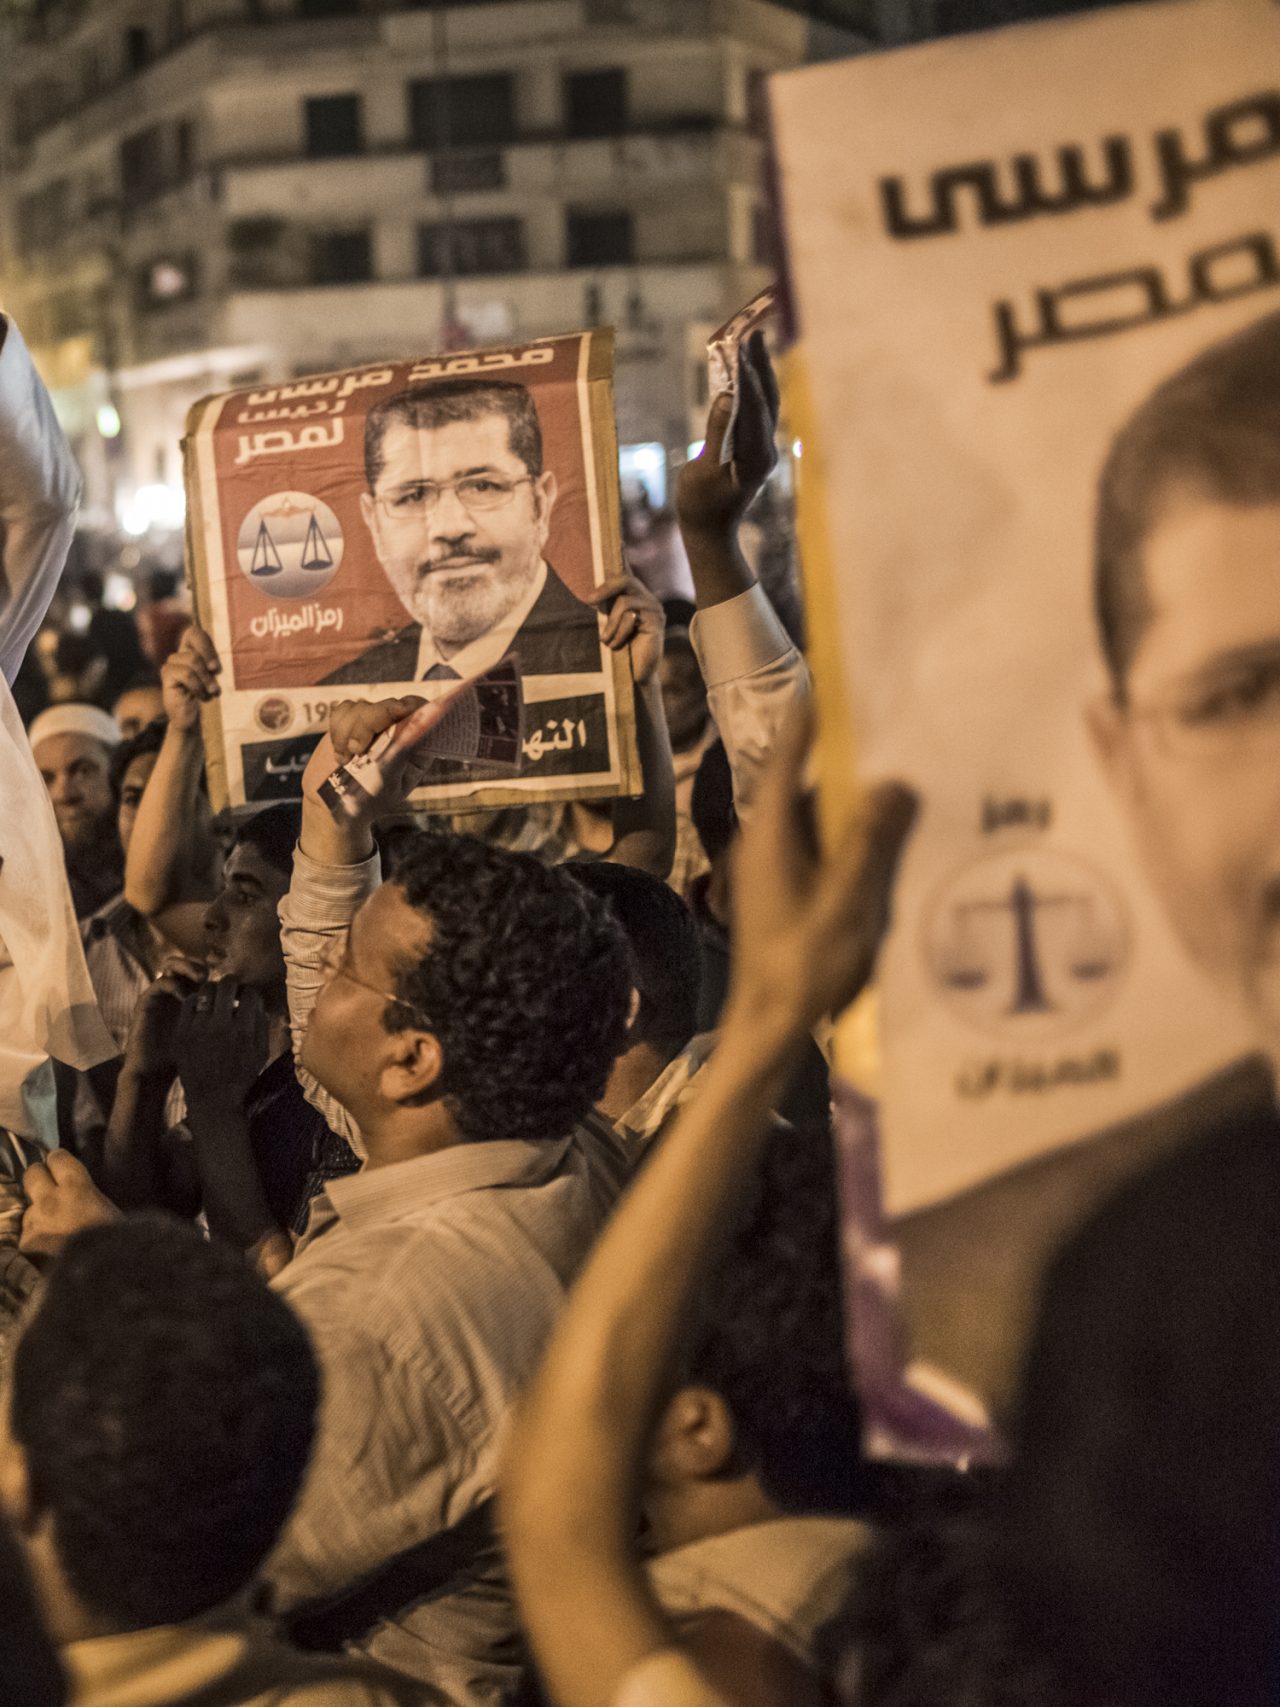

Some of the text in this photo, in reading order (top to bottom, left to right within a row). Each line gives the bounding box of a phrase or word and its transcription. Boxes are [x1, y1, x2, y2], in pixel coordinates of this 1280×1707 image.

[984, 230, 1280, 385] مصر
[408, 347, 555, 382] محمد
[233, 417, 345, 465] لمصر
[249, 602, 344, 638] رمز الميزان
